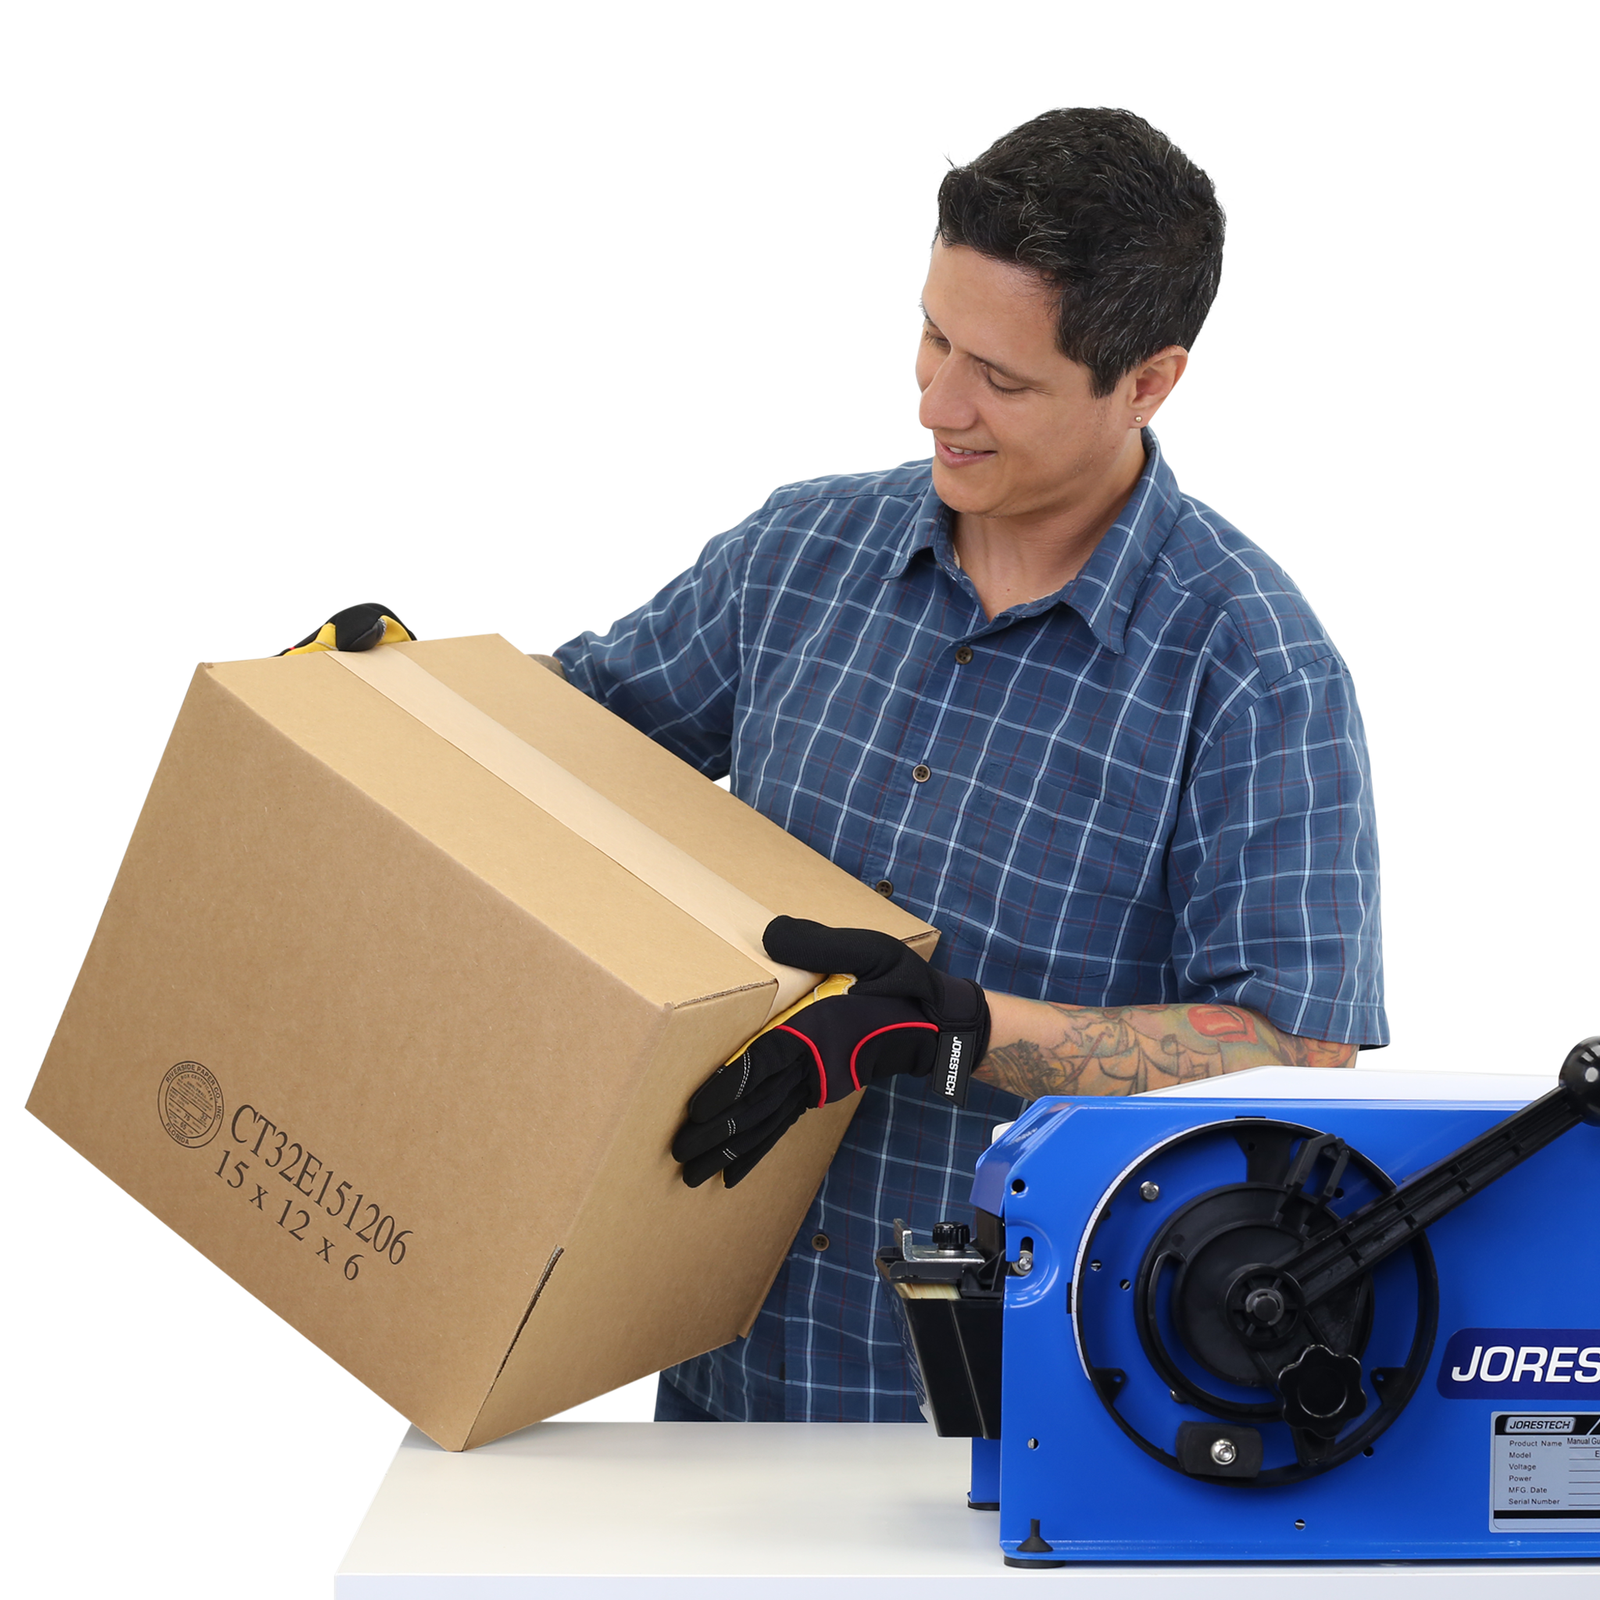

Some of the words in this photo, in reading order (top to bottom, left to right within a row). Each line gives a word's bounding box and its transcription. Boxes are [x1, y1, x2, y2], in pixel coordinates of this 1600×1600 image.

[165, 1064, 196, 1083] RIVERSIDE
[196, 1066, 216, 1085] PAPER
[945, 1036, 963, 1096] JORESTECH
[165, 1122, 190, 1145] FLORIDA
[230, 1103, 414, 1265] CT32E151206
[214, 1149, 250, 1189] 15
[249, 1183, 269, 1211] x
[276, 1199, 311, 1242] 12
[315, 1236, 336, 1264] x
[343, 1253, 365, 1281] 6
[1509, 1420, 1571, 1430] JORESTECH
[1509, 1439, 1538, 1447] Product
[1567, 1437, 1590, 1445] Manual
[1509, 1451, 1531, 1459] Model
[1509, 1463, 1537, 1471] Voltage
